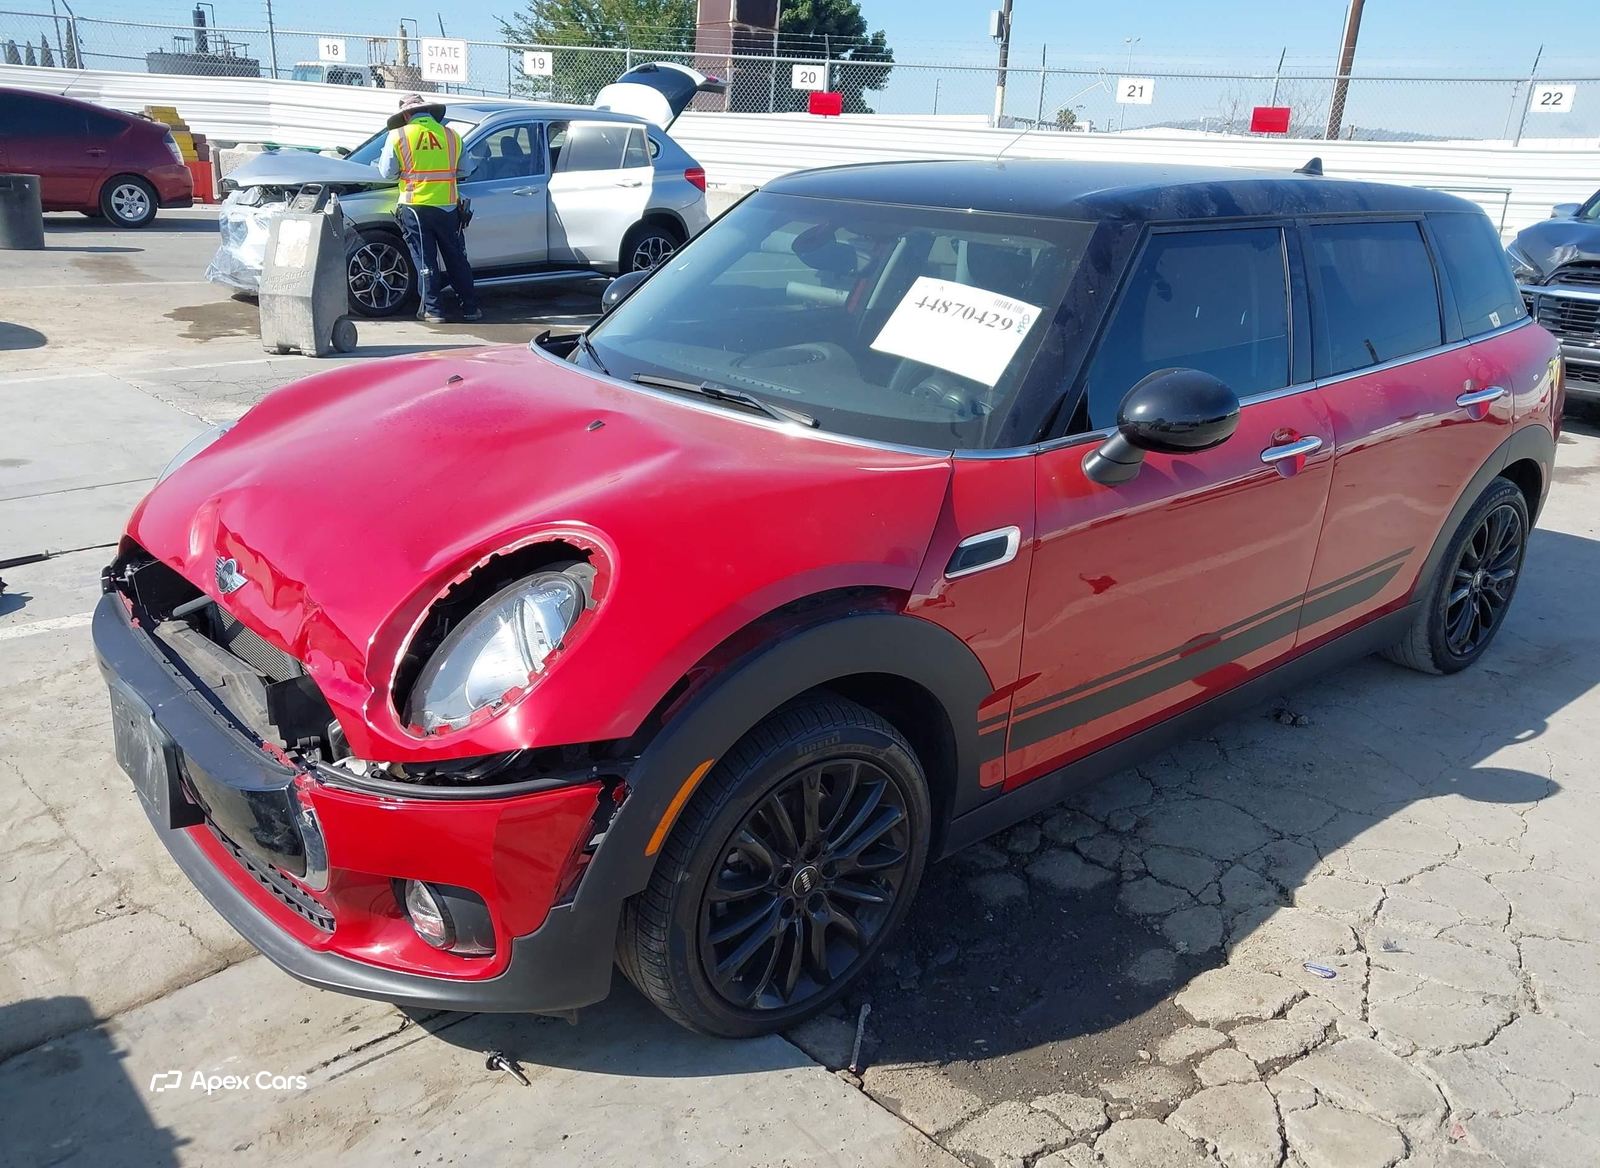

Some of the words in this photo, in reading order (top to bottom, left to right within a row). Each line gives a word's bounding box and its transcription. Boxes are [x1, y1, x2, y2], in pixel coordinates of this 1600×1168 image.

[325, 44, 339, 56] 18
[428, 46, 460, 58] STATE
[429, 63, 459, 75] FARM
[531, 57, 545, 70] 19
[800, 71, 817, 84] 20
[1126, 84, 1144, 98] 21
[1540, 91, 1564, 106] 22
[914, 295, 1014, 331] 44870429
[800, 871, 812, 892] MINI
